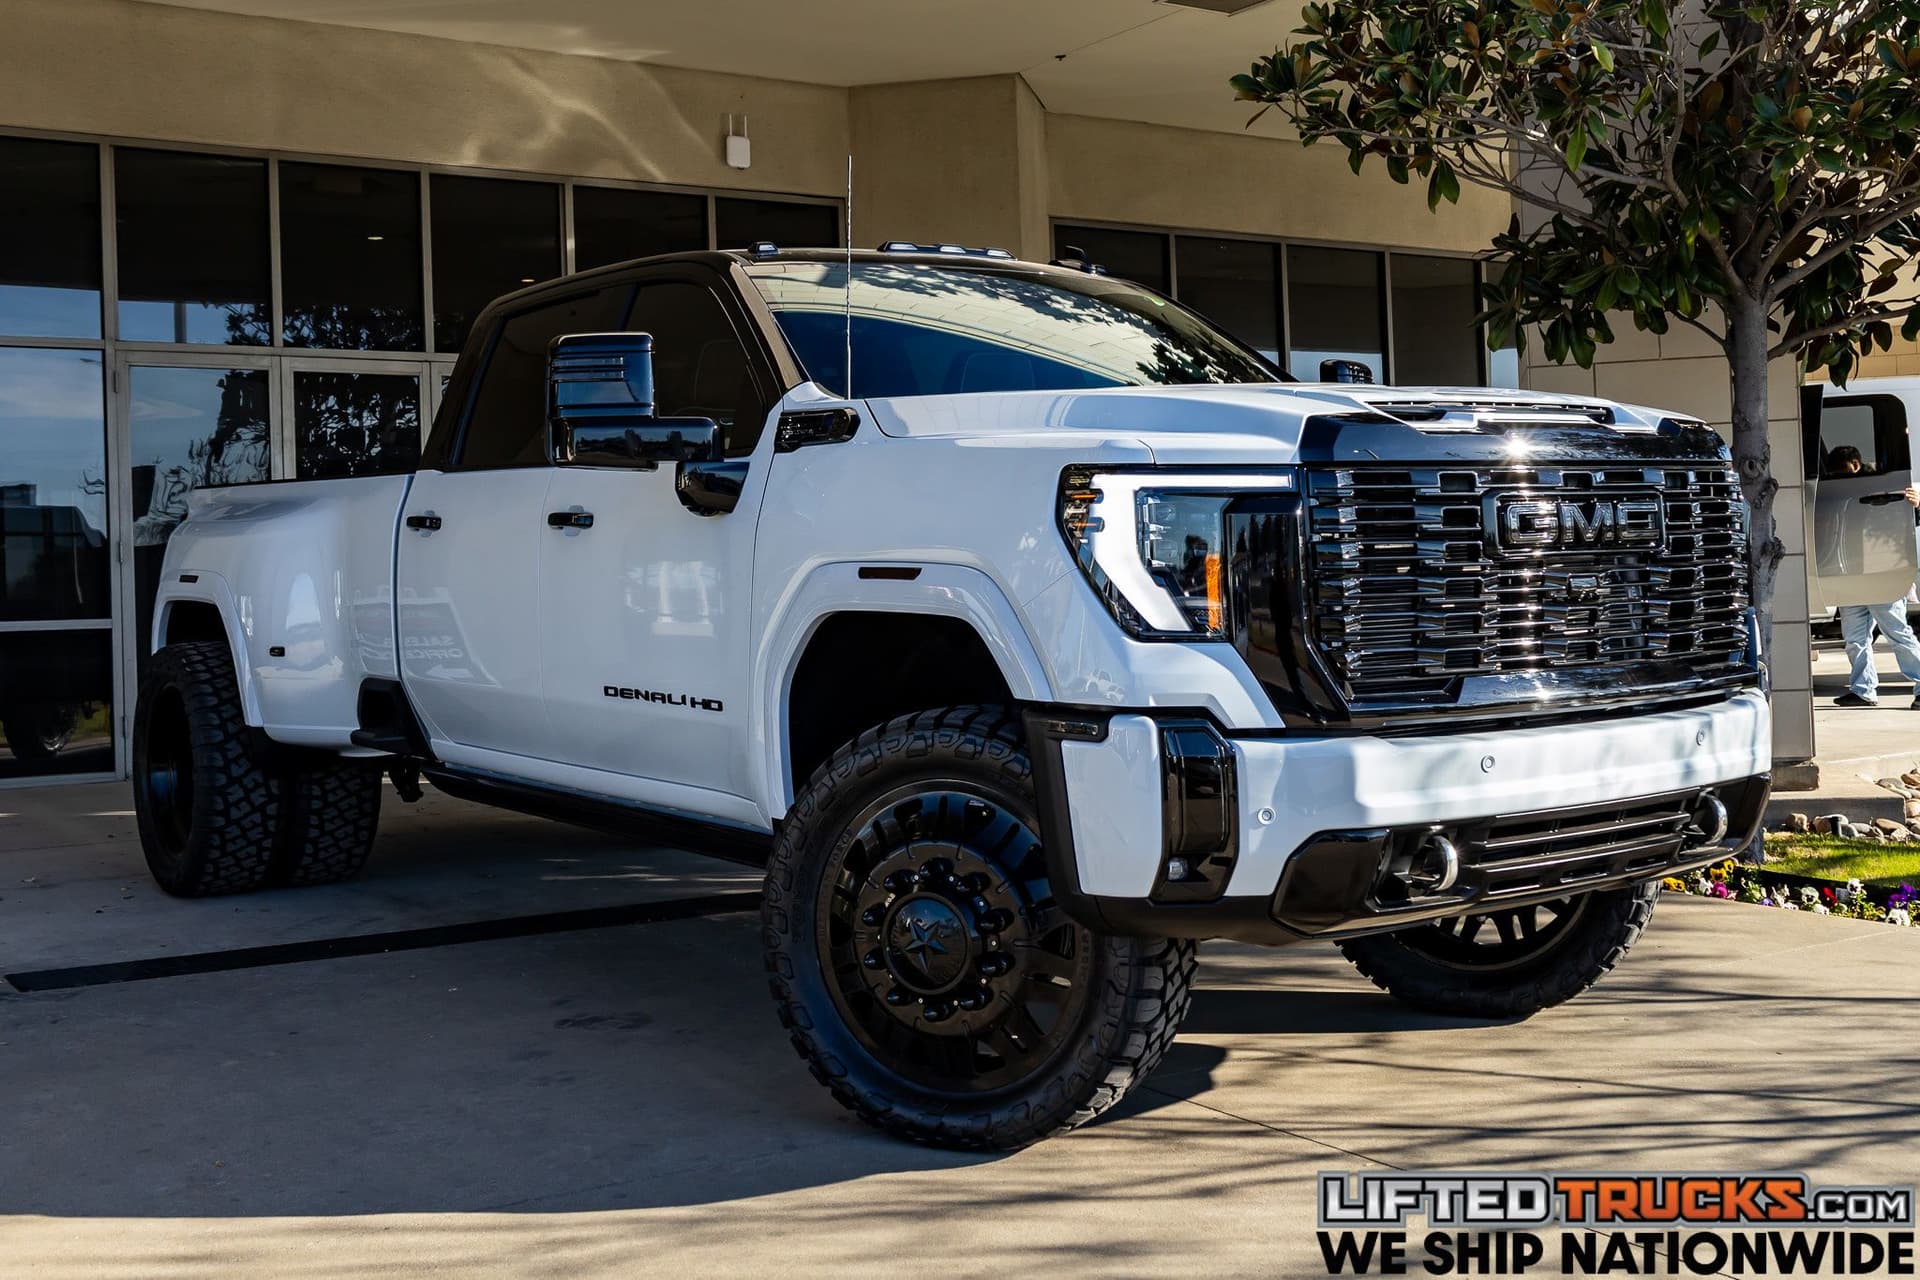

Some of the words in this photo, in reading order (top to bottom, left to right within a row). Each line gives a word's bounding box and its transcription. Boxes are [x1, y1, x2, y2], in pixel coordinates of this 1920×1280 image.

[1506, 502, 1660, 544] GMC
[603, 685, 687, 706] DENALI
[689, 696, 724, 712] HD
